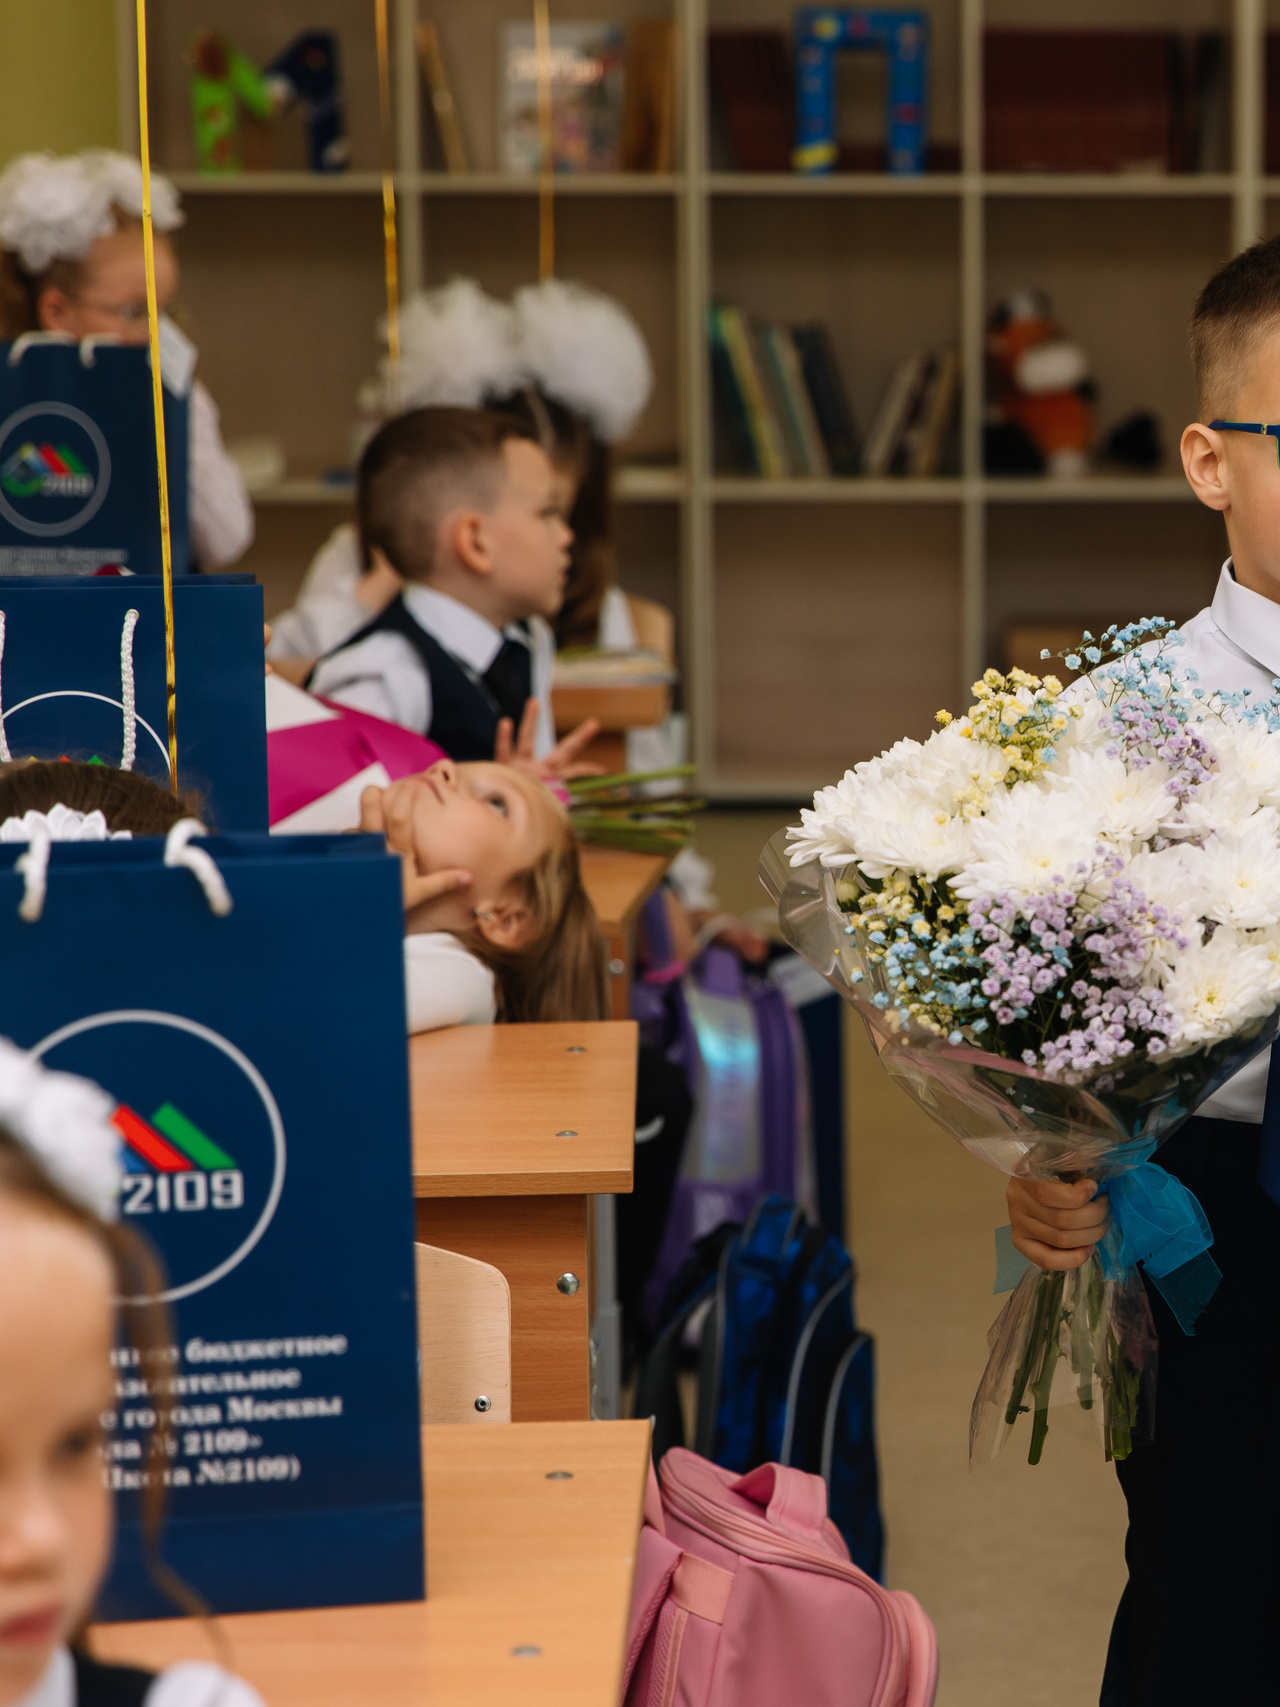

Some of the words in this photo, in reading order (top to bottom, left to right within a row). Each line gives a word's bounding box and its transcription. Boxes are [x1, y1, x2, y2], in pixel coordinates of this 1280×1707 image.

[122, 1169, 245, 1214] 2109
[185, 1334, 349, 1364] бюджетное
[226, 1395, 343, 1423] Москвы
